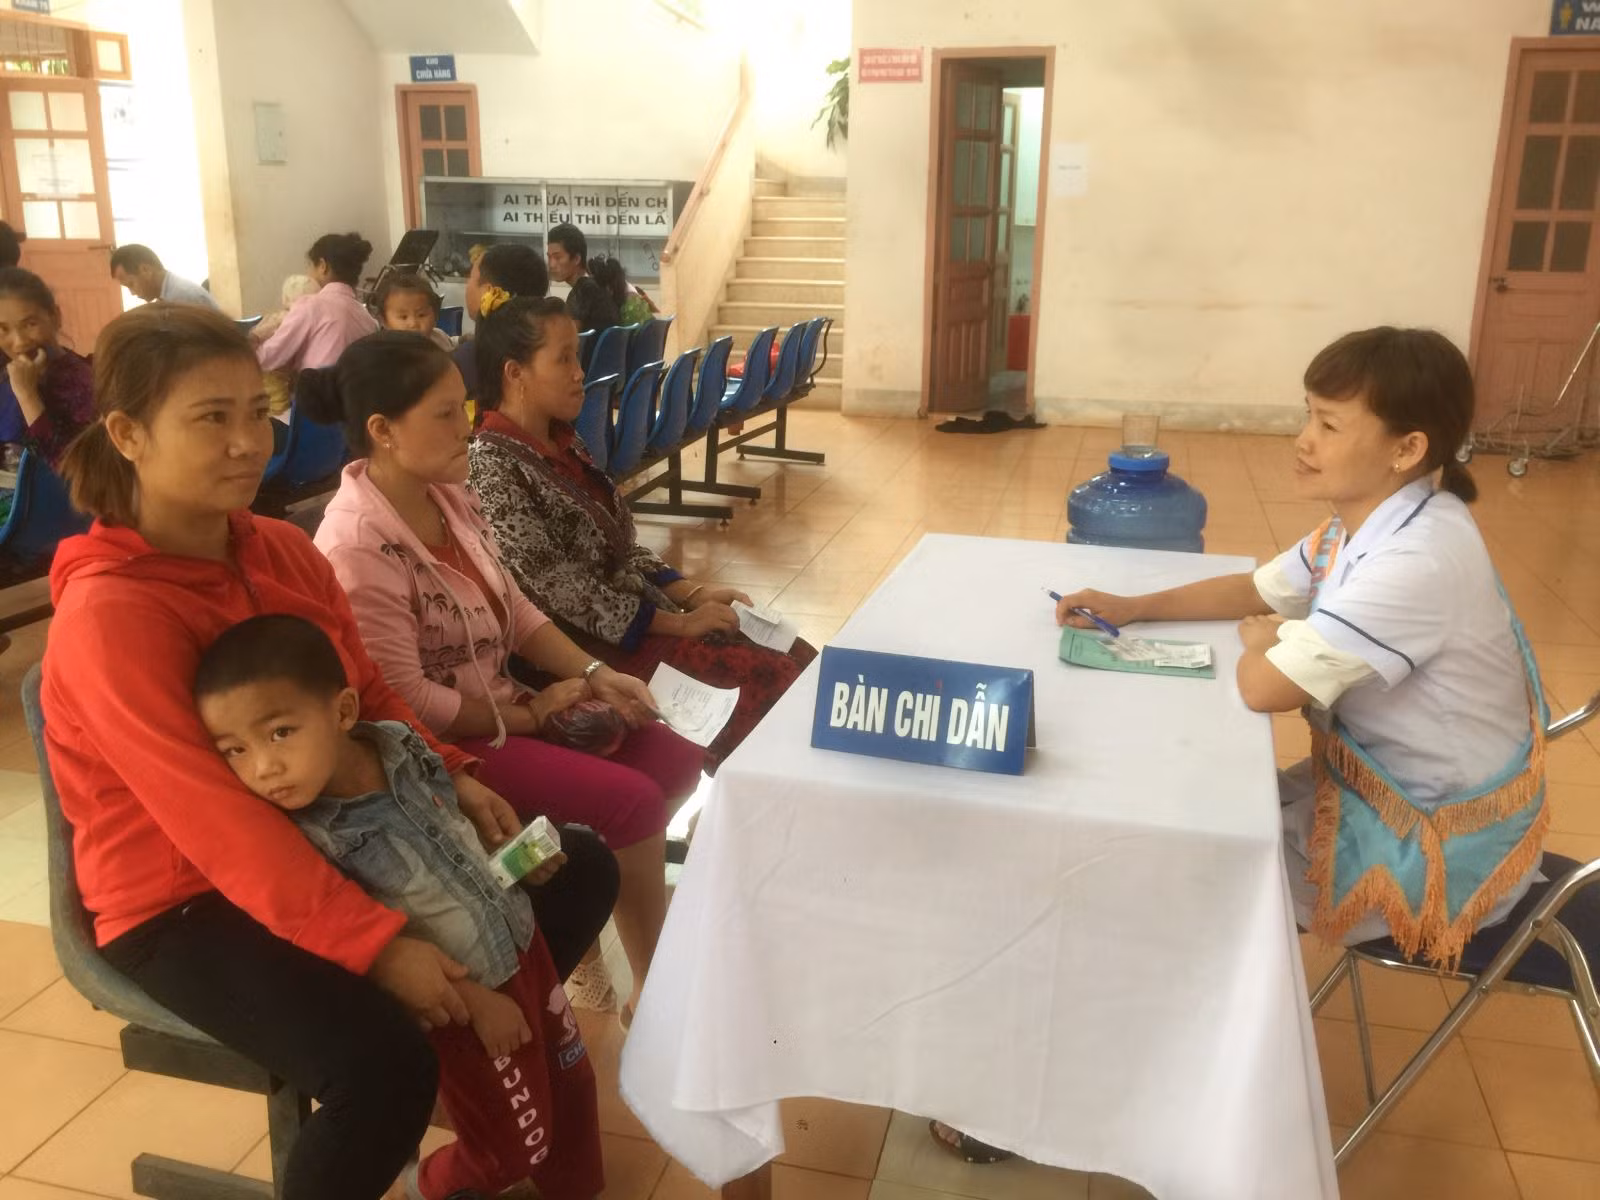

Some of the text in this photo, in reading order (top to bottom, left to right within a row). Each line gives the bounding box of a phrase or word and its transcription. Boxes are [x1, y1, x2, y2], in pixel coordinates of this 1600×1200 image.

[1575, 17, 1600, 31] NA
[503, 194, 519, 205] AI
[574, 192, 600, 207] THÌ
[645, 197, 668, 208] CH
[503, 211, 519, 223] AI
[524, 208, 570, 224] THẾU
[575, 210, 601, 225] THÌ
[645, 208, 667, 225] LẤ
[830, 674, 888, 734] BÀN
[946, 682, 1009, 752] DẪN
